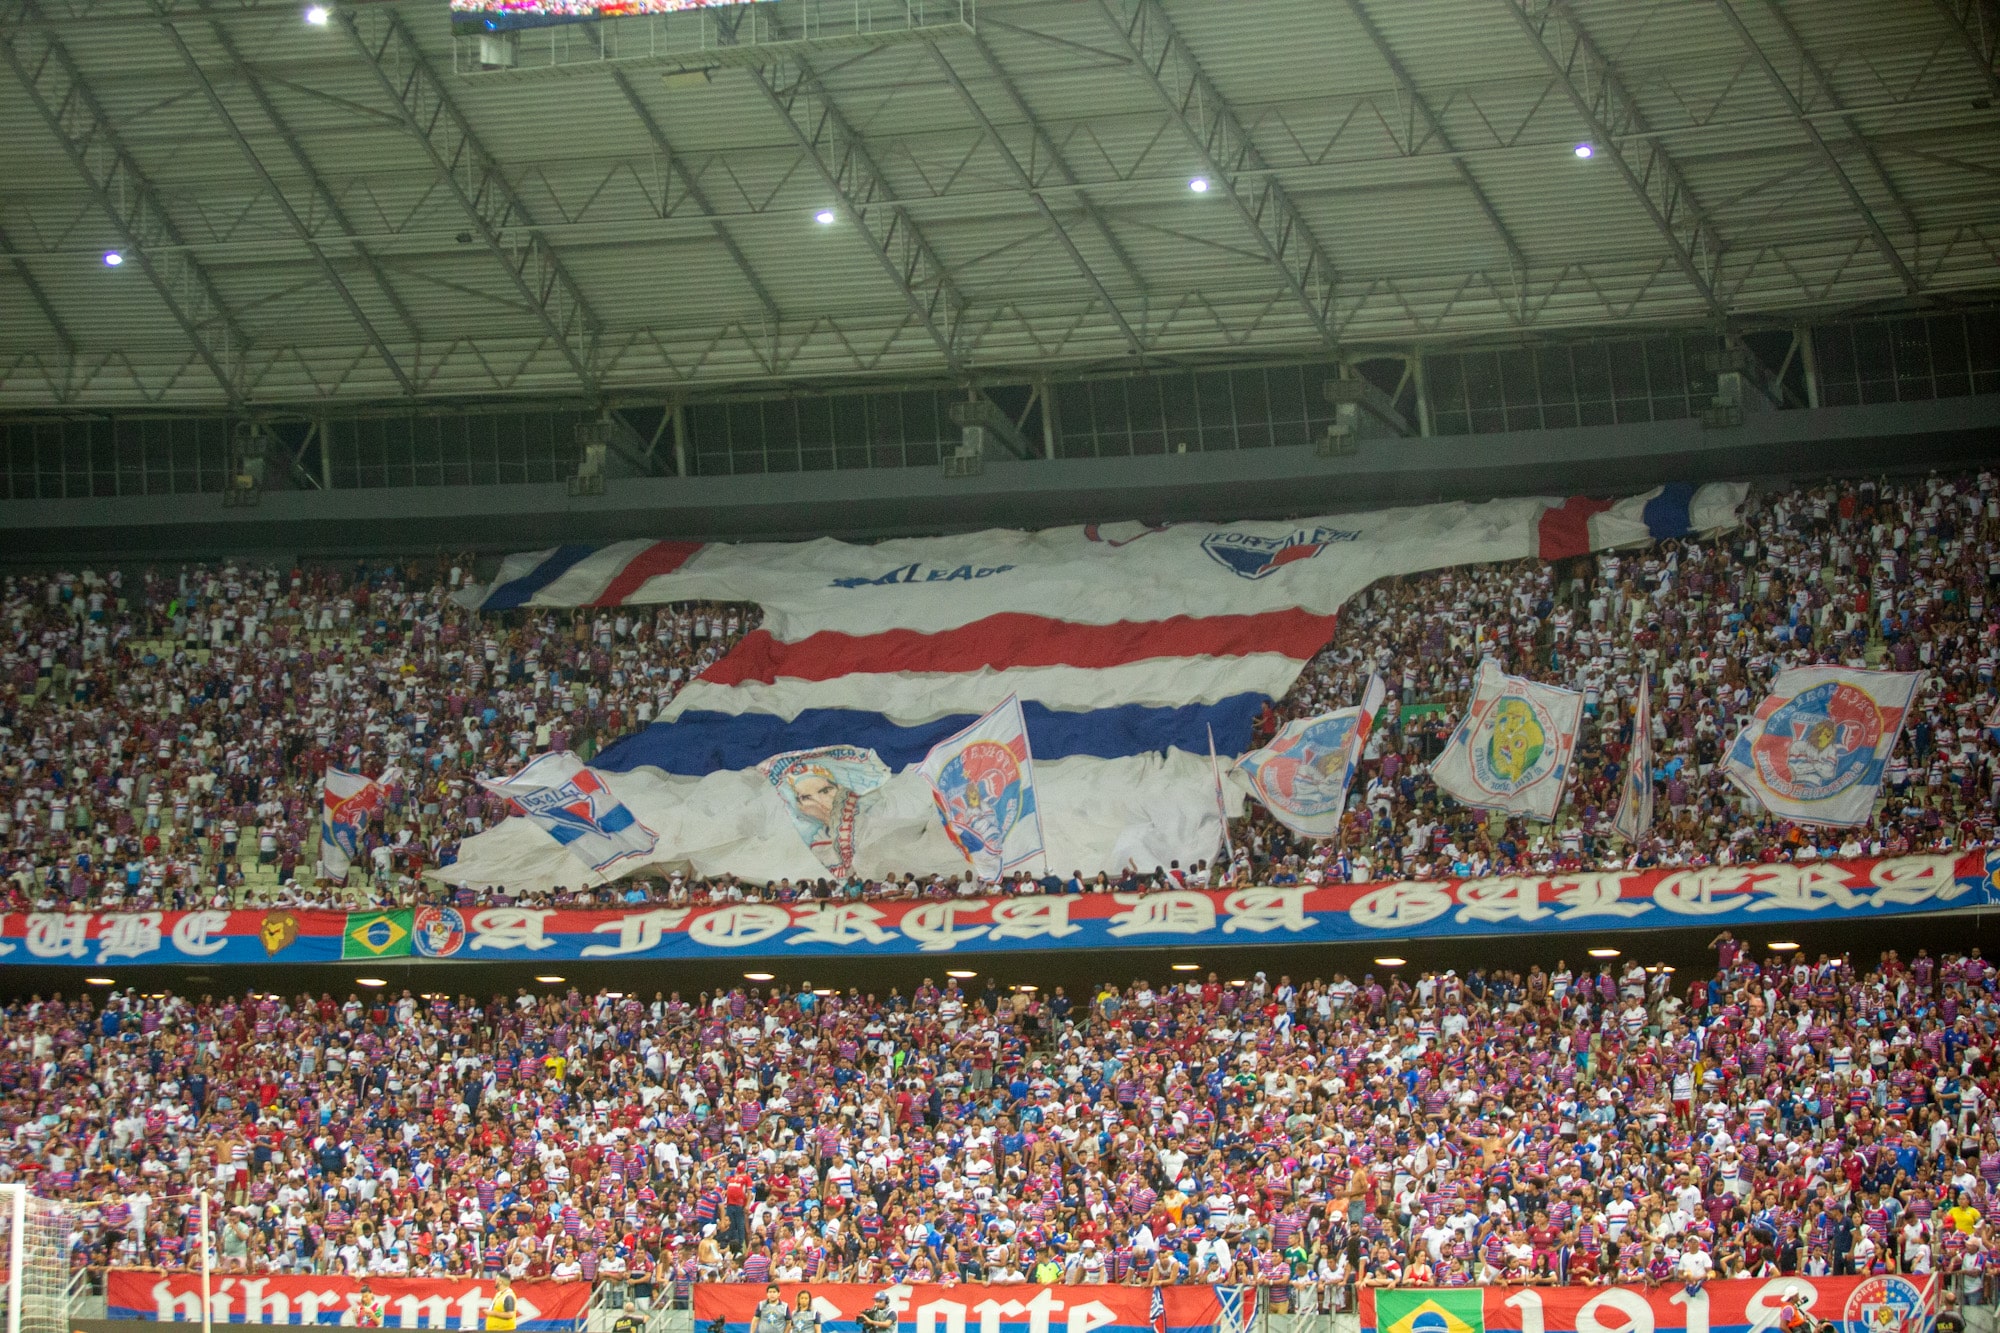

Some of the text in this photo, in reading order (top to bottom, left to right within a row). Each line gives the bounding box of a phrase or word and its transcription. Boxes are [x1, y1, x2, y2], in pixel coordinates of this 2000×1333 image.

[0, 910, 229, 964] UBE
[1106, 886, 1320, 937] DA
[1349, 851, 1972, 929] GALERA
